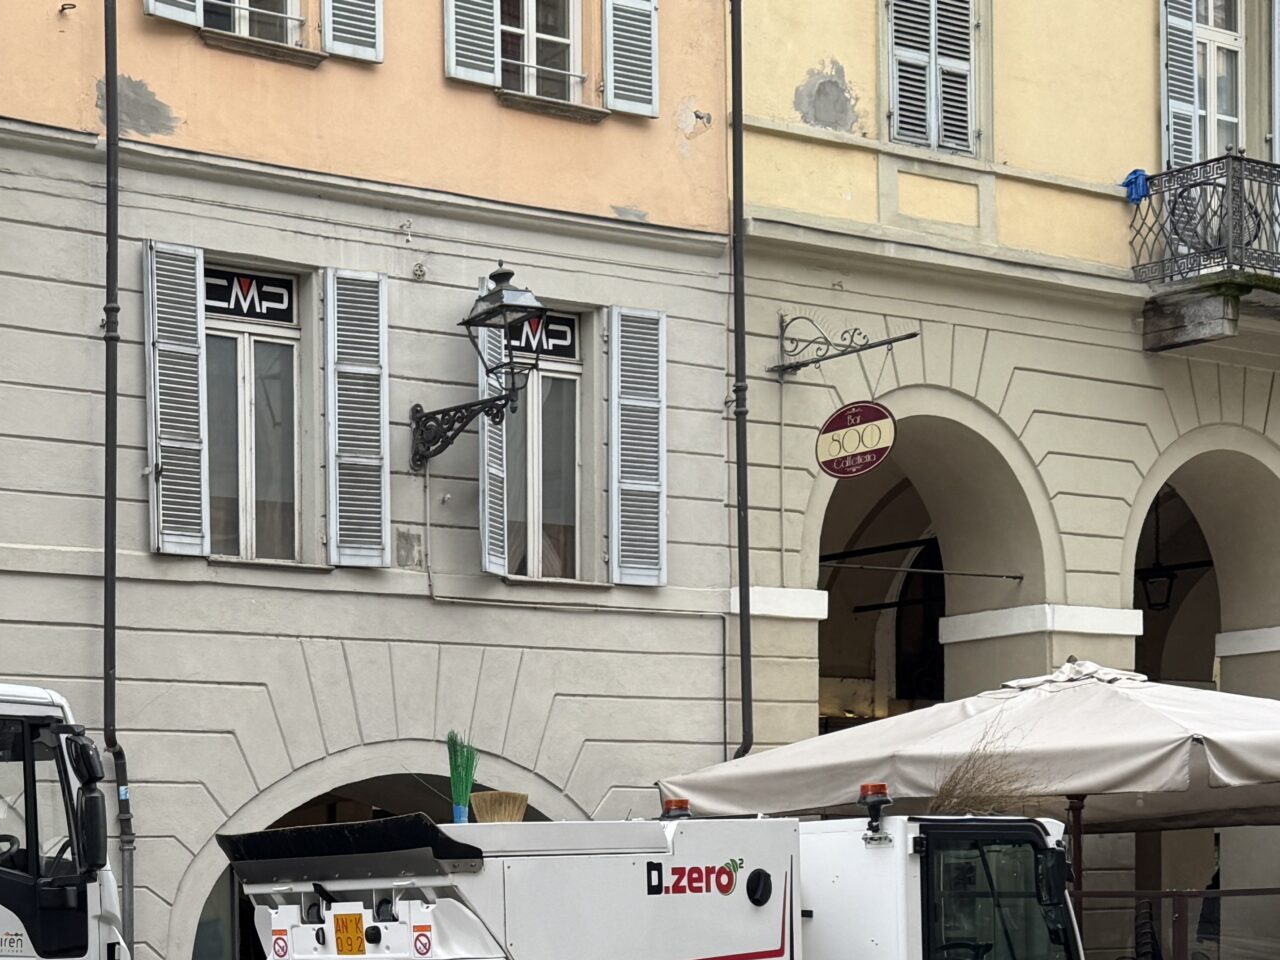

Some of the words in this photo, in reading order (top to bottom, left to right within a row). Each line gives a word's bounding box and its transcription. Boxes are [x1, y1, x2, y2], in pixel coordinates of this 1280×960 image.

[204, 275, 289, 314] CMP
[847, 414, 861, 426] Bar
[0, 936, 23, 948] iren
[336, 936, 364, 952] 092
